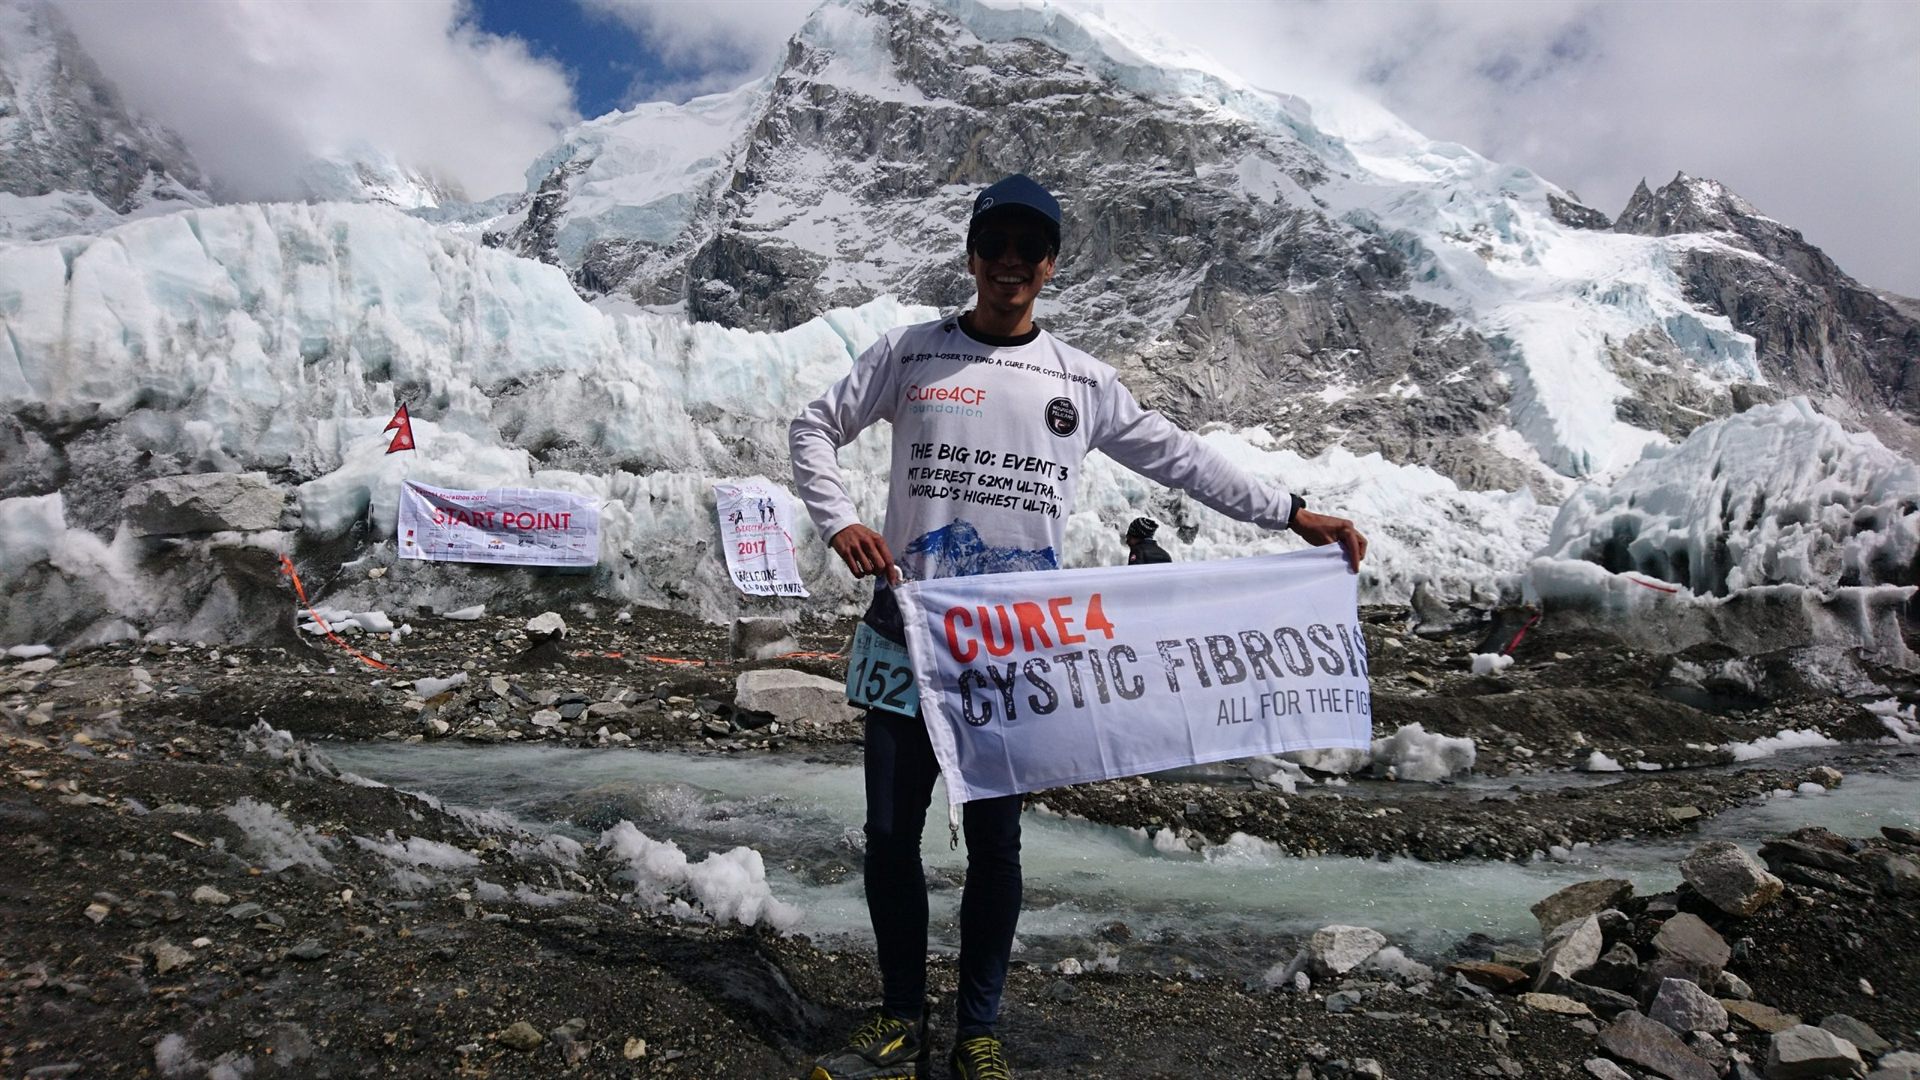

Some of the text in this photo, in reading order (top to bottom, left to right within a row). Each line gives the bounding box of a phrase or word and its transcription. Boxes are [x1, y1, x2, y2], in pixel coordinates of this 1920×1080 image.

[901, 353, 914, 364] ONE
[935, 352, 961, 361] LOSER
[962, 354, 973, 362] TO
[975, 355, 994, 364] FIND
[996, 358, 1002, 366] A
[1004, 360, 1024, 369] CURE
[1026, 364, 1041, 374] FOR
[1042, 368, 1067, 380] CYSTIC
[906, 384, 986, 406] Cure4CF
[911, 403, 983, 417] oundation
[911, 443, 1069, 481] THE BIG 10: EVENT 3
[908, 467, 919, 481] MT
[921, 467, 975, 486] EVEREST
[977, 474, 1014, 492] 62KM
[908, 483, 1062, 520] (WORLD'S HIGHEST ULTRA)
[433, 506, 571, 532] START POINT
[738, 541, 766, 555] 2017
[943, 592, 1115, 664] CURE4
[855, 657, 914, 709] 152
[959, 623, 1369, 727] CYSTIC FIBROSIS
[1216, 688, 1372, 726] ALL FOR THE FIG
